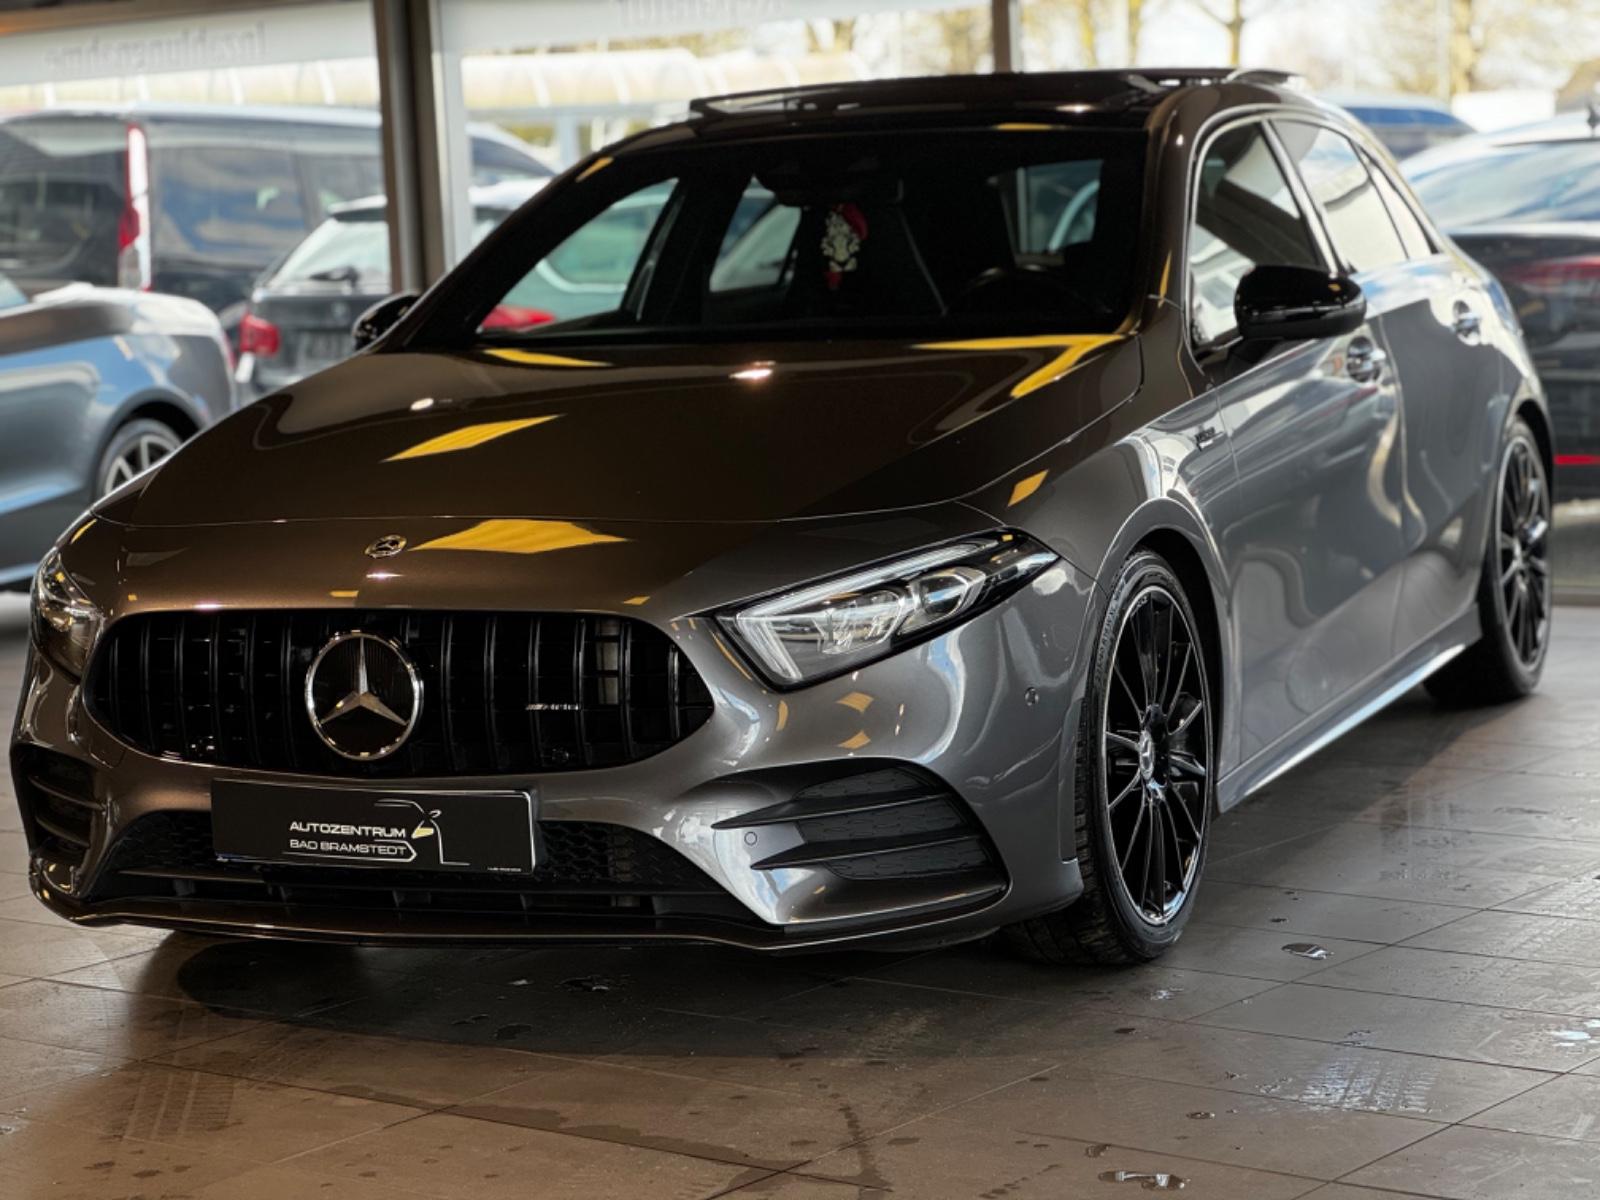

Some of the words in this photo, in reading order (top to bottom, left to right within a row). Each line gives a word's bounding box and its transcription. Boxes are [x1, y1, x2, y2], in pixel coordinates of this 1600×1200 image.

[289, 821, 406, 838] AUTOZENTRUM
[290, 839, 318, 850] BAD
[320, 841, 407, 855] BRAMSTEDT
